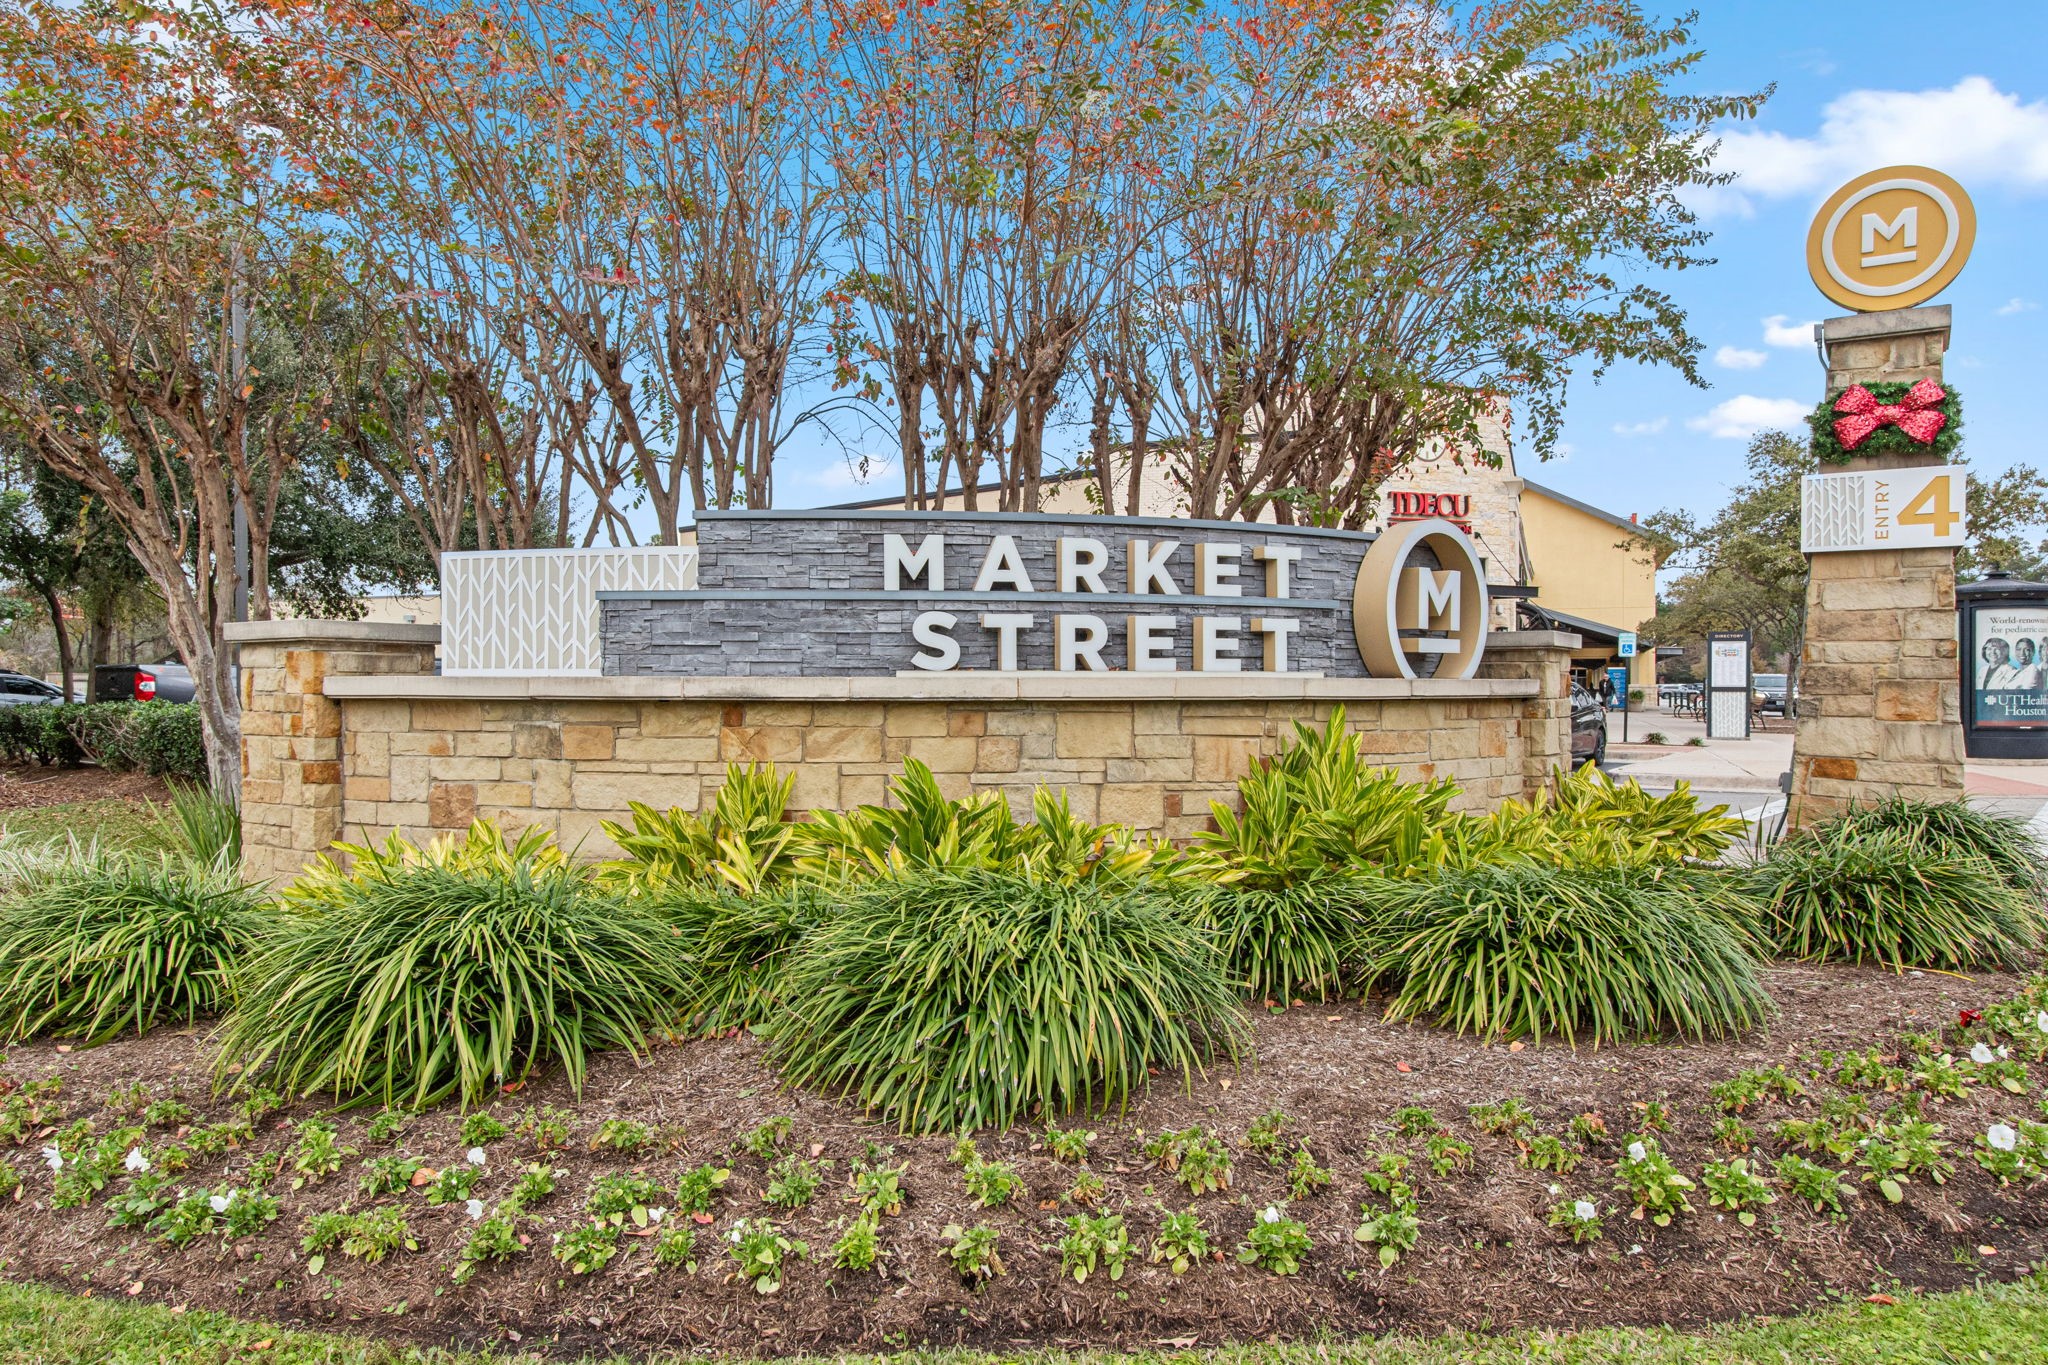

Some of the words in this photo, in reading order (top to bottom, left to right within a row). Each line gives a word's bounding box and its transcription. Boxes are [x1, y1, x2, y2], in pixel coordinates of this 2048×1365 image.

[1861, 207, 1917, 253] M
[1388, 491, 1472, 518] TDECU
[1875, 480, 1889, 540] ENTRY
[1897, 476, 1959, 536] 4
[883, 534, 1301, 598] MARKET
[1418, 567, 1461, 631] M
[910, 611, 1300, 672] STREET
[1991, 625, 2002, 633] for
[2005, 626, 2038, 635] pediatric
[2005, 705, 2047, 716] Houston
